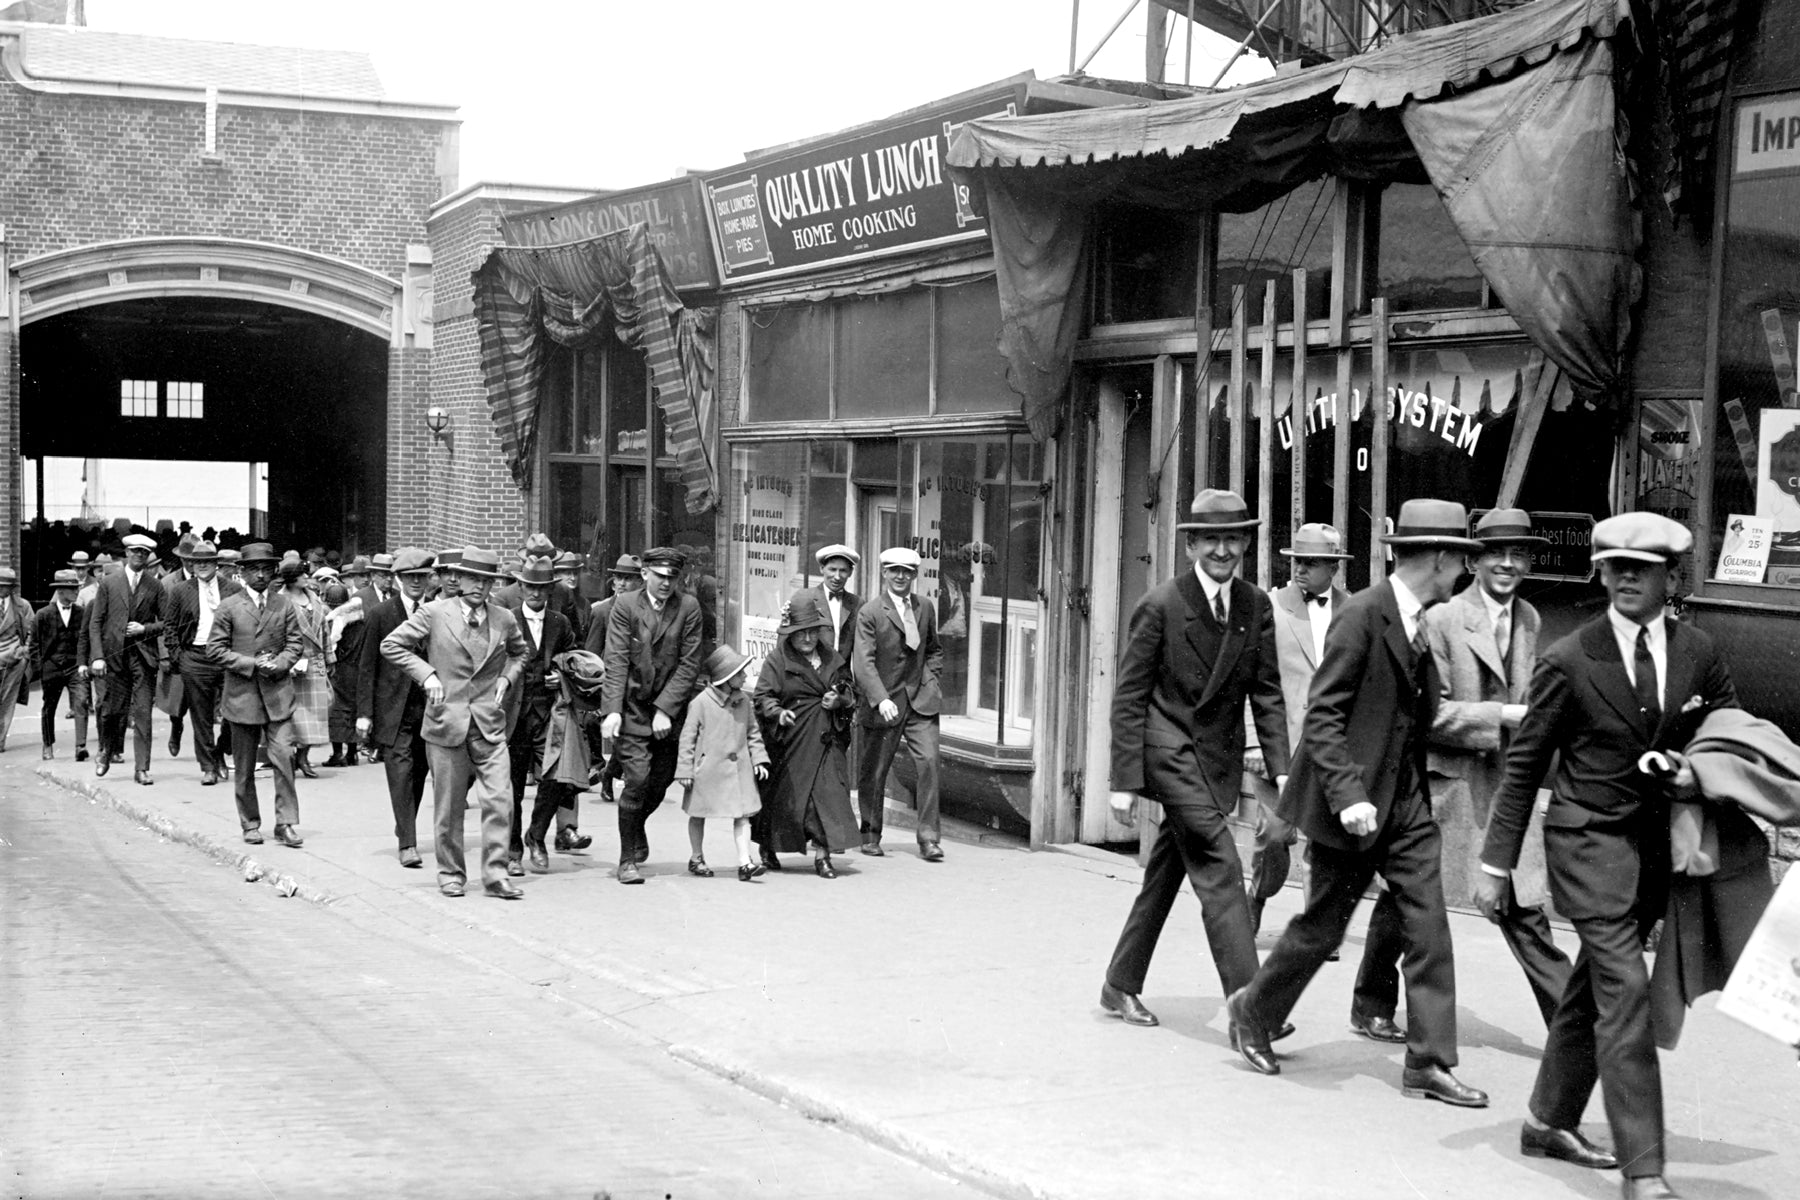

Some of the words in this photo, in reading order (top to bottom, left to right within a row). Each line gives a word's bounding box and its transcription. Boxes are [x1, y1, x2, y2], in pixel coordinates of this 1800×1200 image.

[765, 156, 857, 228] QUALITY
[860, 134, 943, 202] LUNCH
[716, 201, 731, 217] BOX
[729, 193, 756, 214] LUNCHES
[523, 212, 588, 247] MASON
[791, 223, 837, 251] HOME
[842, 204, 917, 241] COOKING
[736, 237, 754, 254] PIES
[1387, 386, 1484, 457] SYSTEM
[1650, 431, 1690, 444] SMOKE
[732, 523, 802, 547] DELICATESSEN
[1566, 526, 1590, 546] food
[1723, 554, 1763, 569] COLUMBIA
